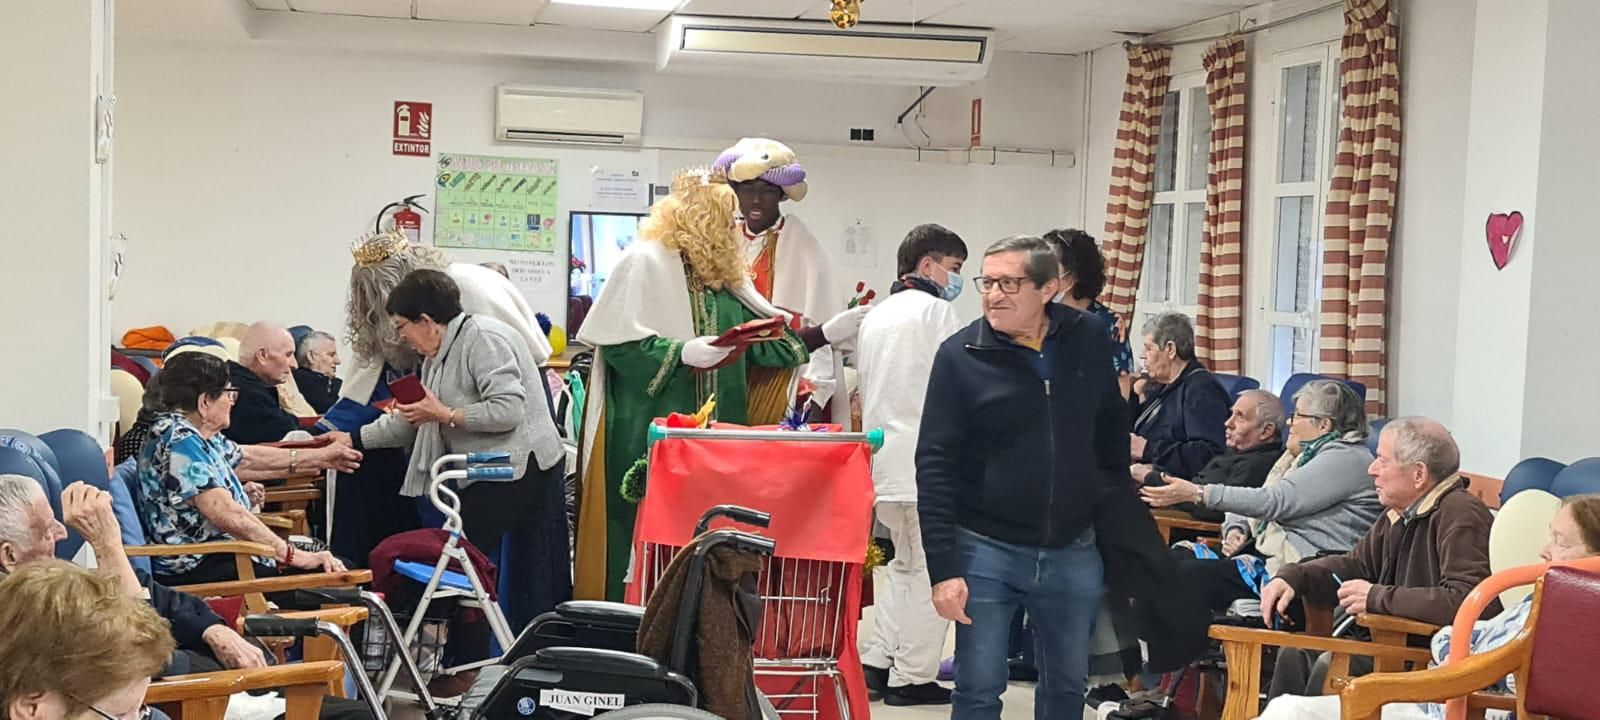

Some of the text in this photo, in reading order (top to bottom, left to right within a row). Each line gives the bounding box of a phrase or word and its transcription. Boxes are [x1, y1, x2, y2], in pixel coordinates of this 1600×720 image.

[394, 142, 430, 153] EXTINTOR
[548, 694, 622, 707] JUAN GINEL
